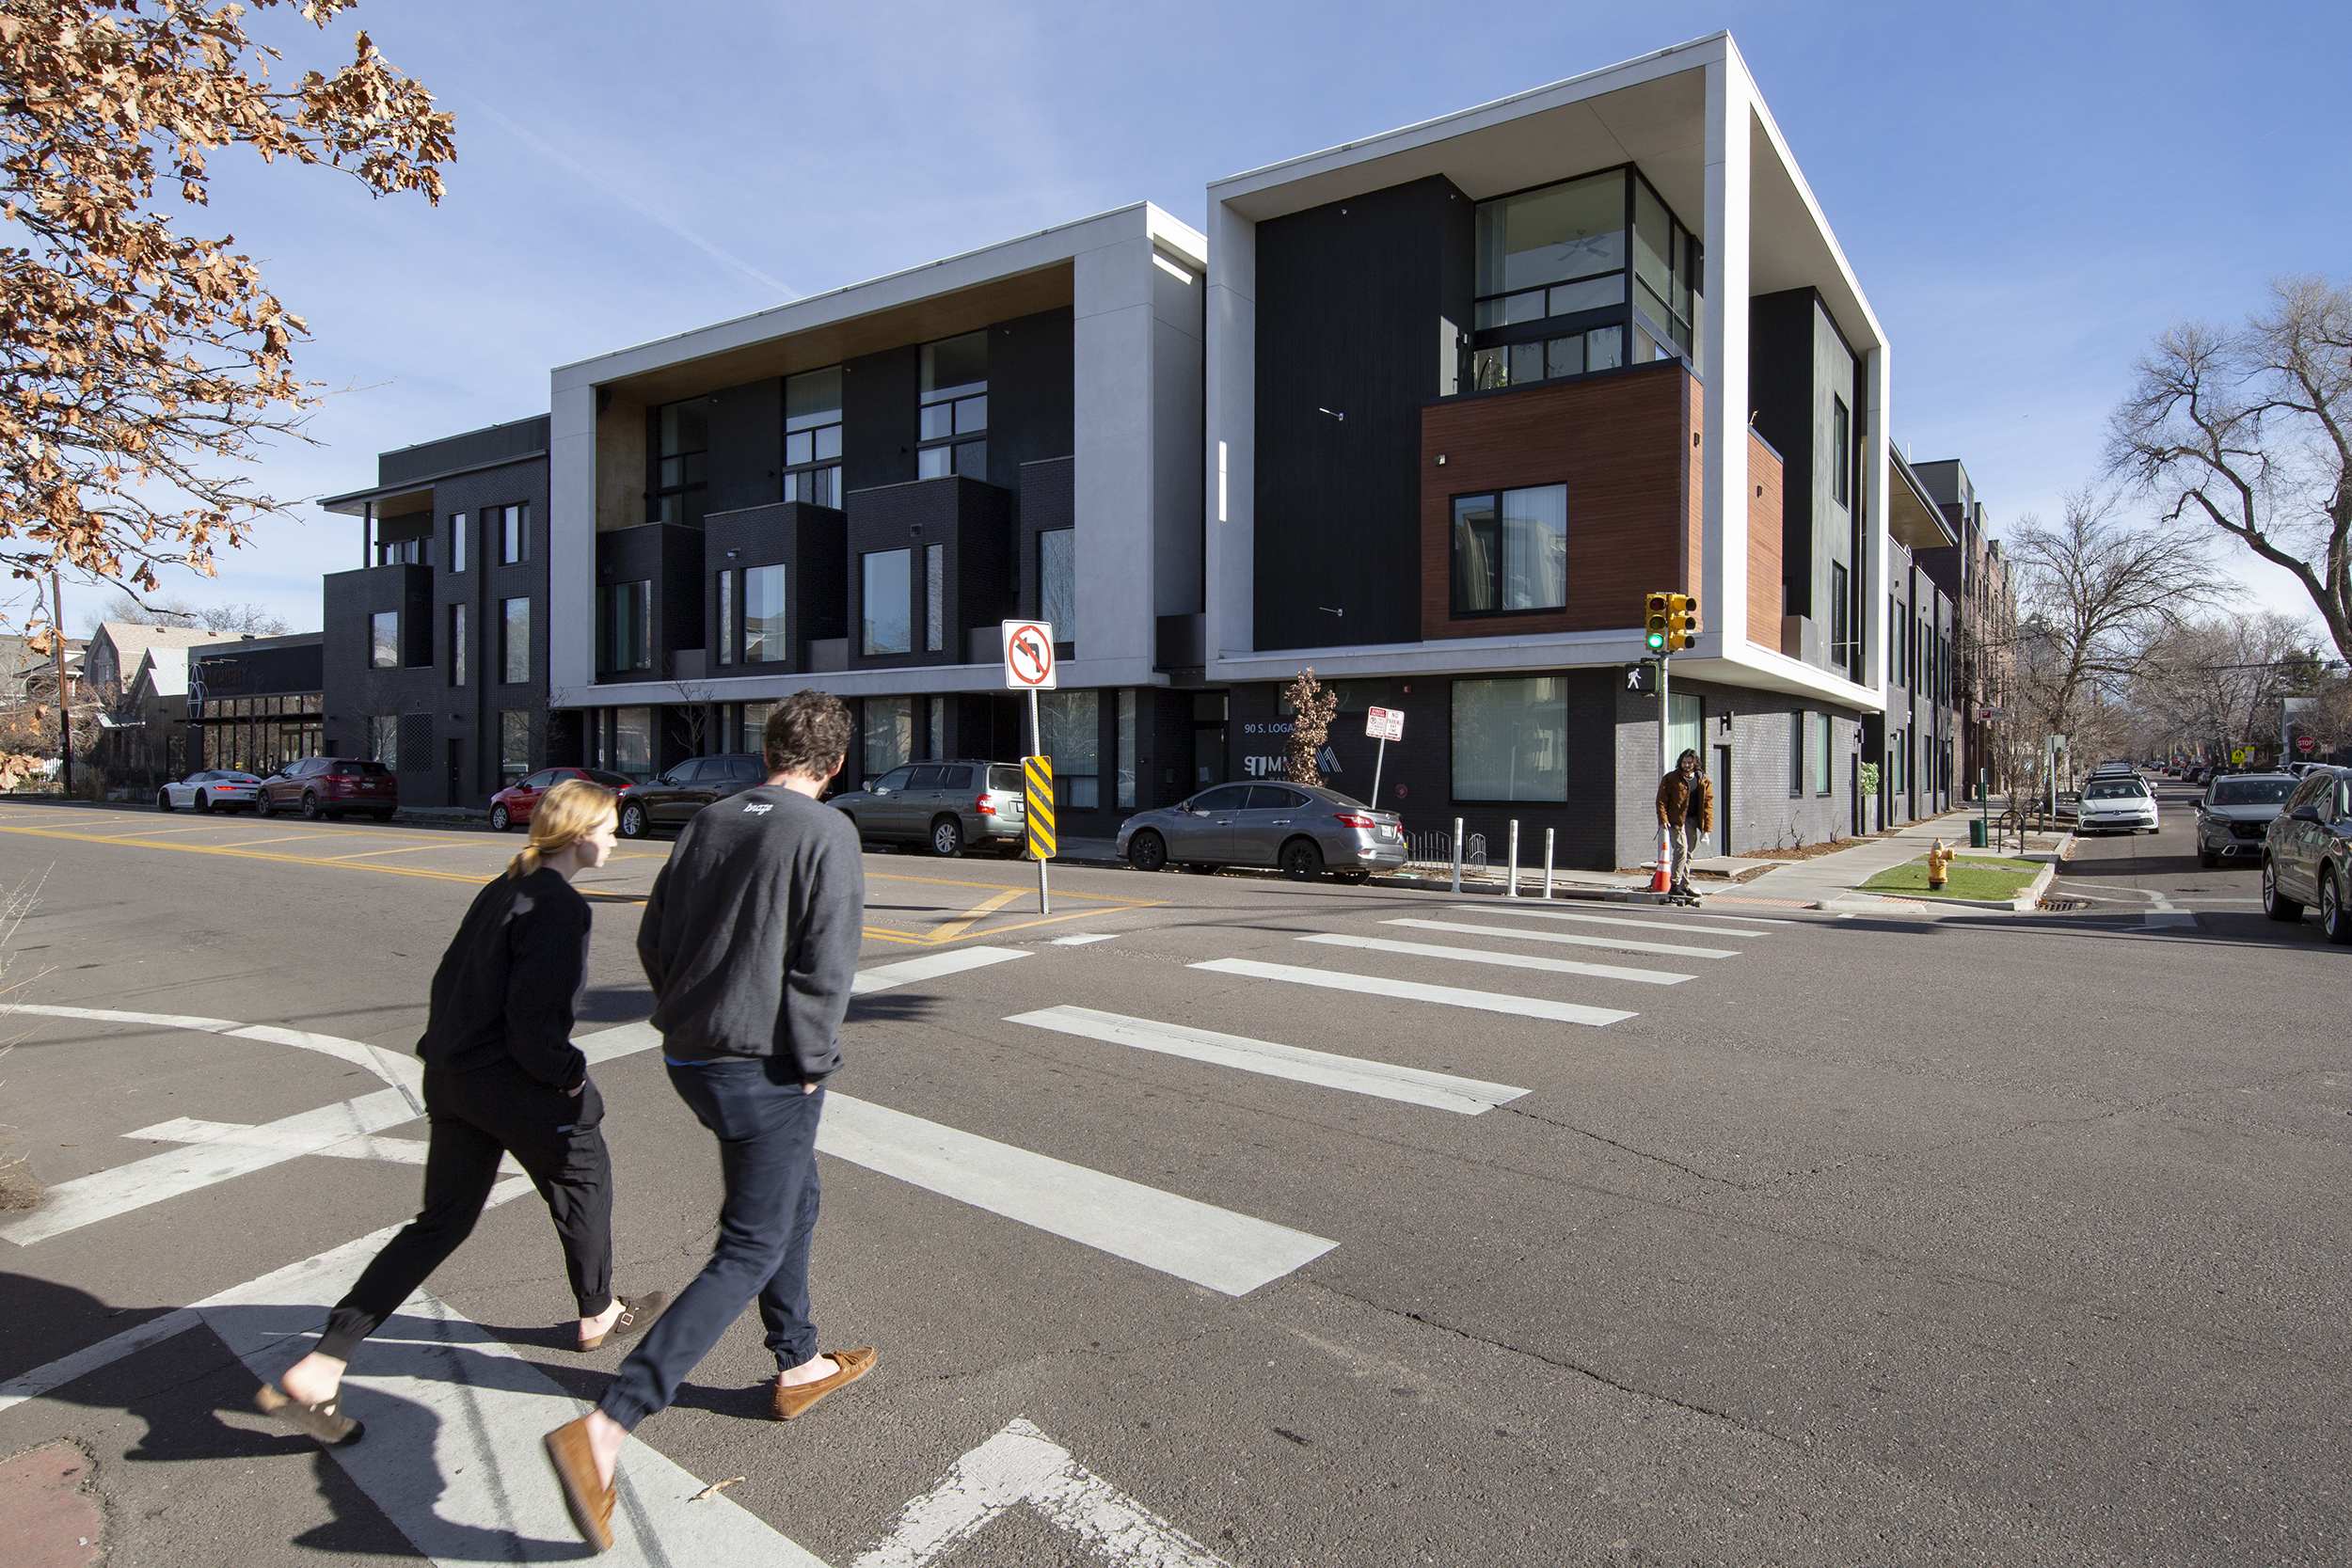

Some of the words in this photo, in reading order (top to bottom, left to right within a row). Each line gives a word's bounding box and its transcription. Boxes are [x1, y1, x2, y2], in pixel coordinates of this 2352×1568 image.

[1244, 723, 1256, 734] 90
[1258, 723, 1266, 734] S.
[1268, 723, 1295, 734] LOGA
